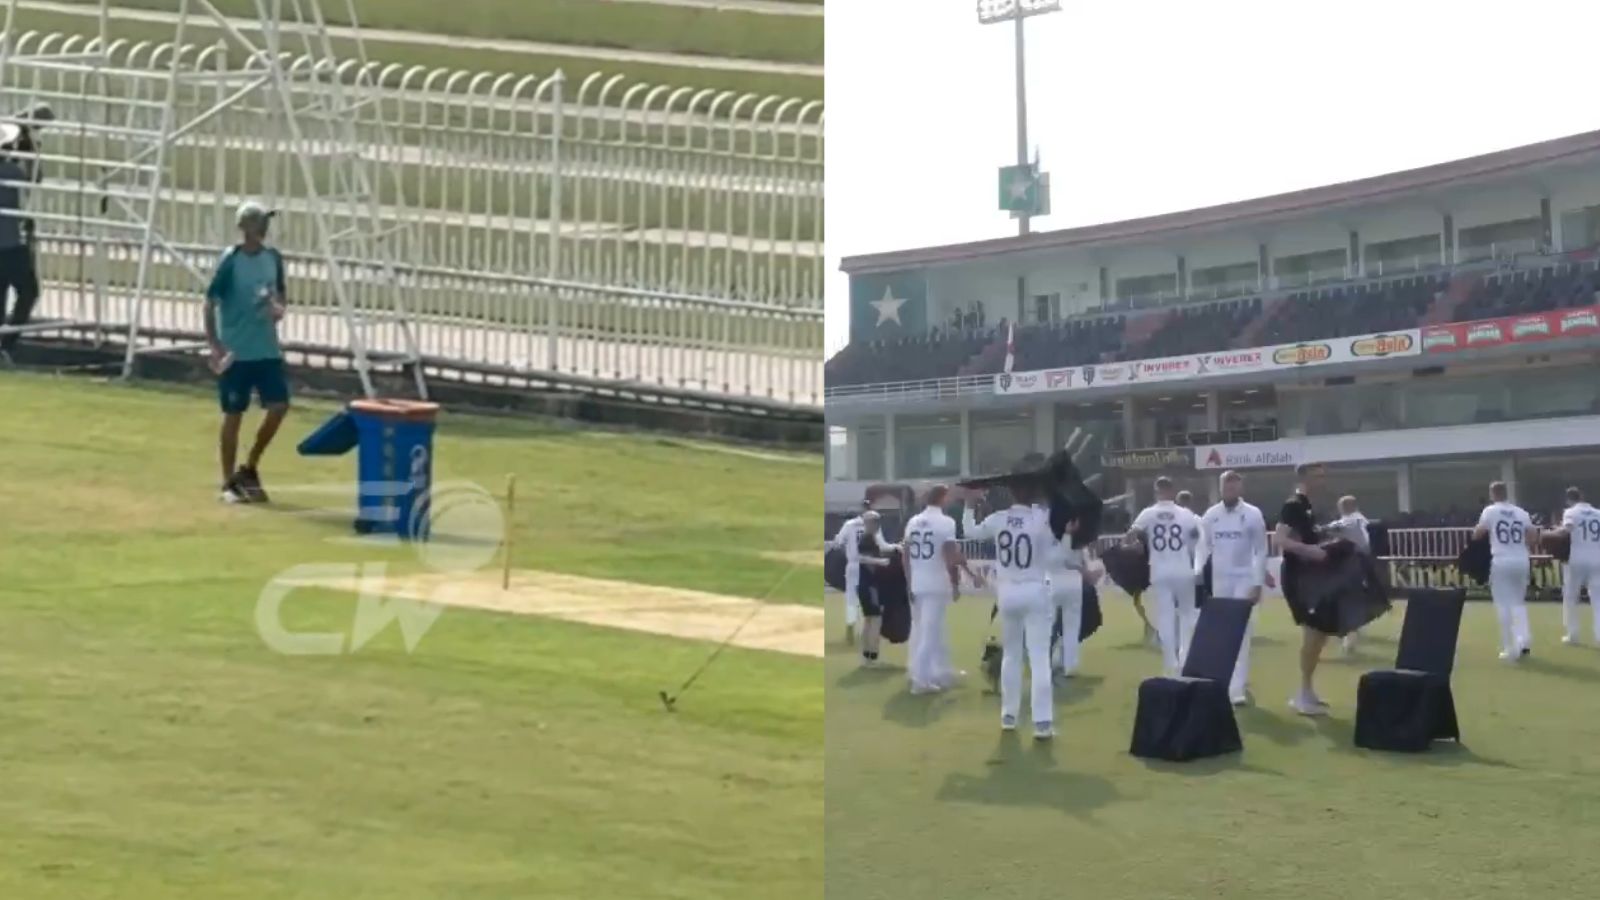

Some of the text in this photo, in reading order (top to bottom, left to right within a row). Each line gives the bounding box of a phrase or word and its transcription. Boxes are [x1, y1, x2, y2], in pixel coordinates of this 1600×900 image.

[1254, 451, 1293, 465] Alfalah
[1152, 523, 1183, 552] 88
[1496, 520, 1524, 544] 66
[1578, 518, 1600, 542] 19
[998, 530, 1032, 569] 80
